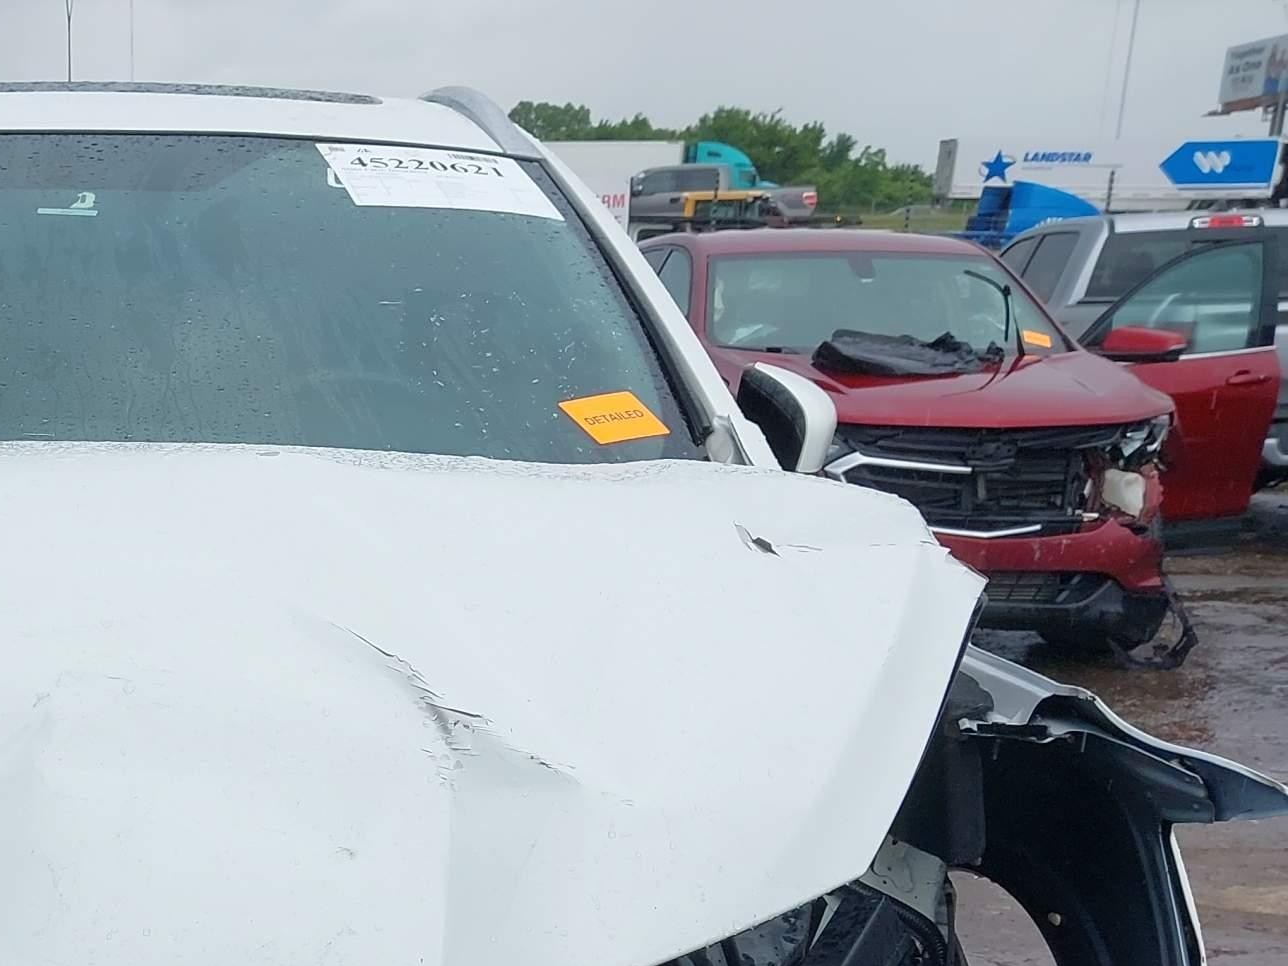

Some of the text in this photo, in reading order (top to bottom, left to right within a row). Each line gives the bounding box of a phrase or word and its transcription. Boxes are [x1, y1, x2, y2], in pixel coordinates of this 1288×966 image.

[1024, 151, 1092, 163] LANDSTAR
[350, 156, 505, 178] 45220621
[584, 410, 644, 425] DETAILED
